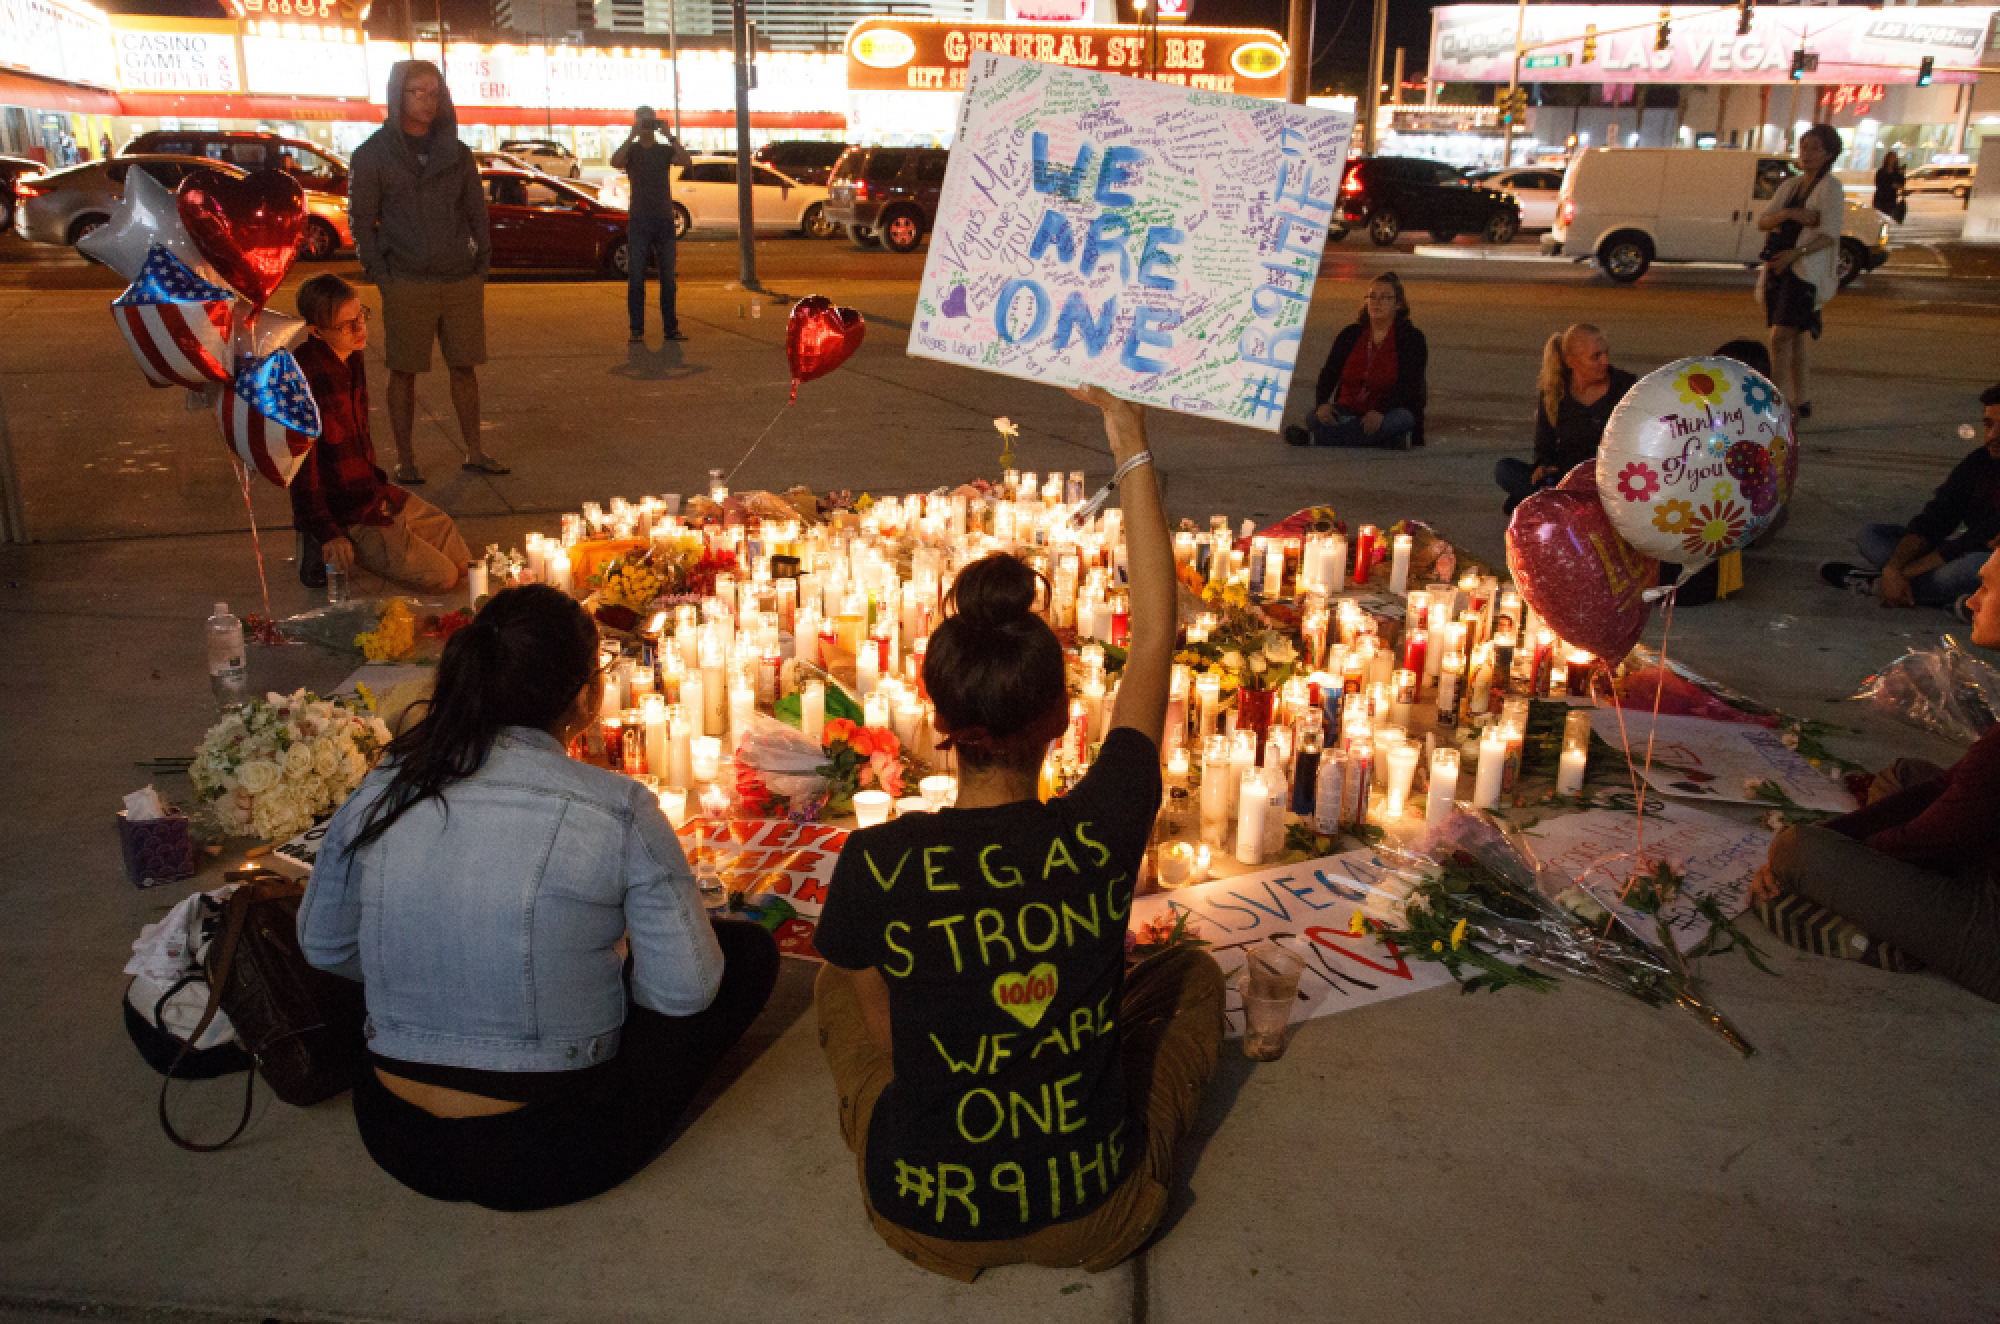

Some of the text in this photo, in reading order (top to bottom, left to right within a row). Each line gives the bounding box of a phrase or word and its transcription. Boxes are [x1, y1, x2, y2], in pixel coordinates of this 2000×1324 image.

[122, 34, 207, 52] CASINO
[125, 52, 205, 69] GAMES
[943, 31, 1098, 66] GENERAL
[1683, 34, 1812, 72] VEGA
[1031, 131, 1146, 209] WE
[938, 209, 987, 273] Vegas
[1028, 210, 1185, 291] ARE
[994, 279, 1184, 374] ONE
[1662, 436, 1702, 486] of
[1687, 462, 1724, 493] you
[864, 821, 1111, 892] VEGAS
[883, 871, 1131, 978] STRONG
[999, 973, 1055, 1006] 10/01
[1031, 987, 1115, 1059] ARE
[956, 1072, 1086, 1144] ONE
